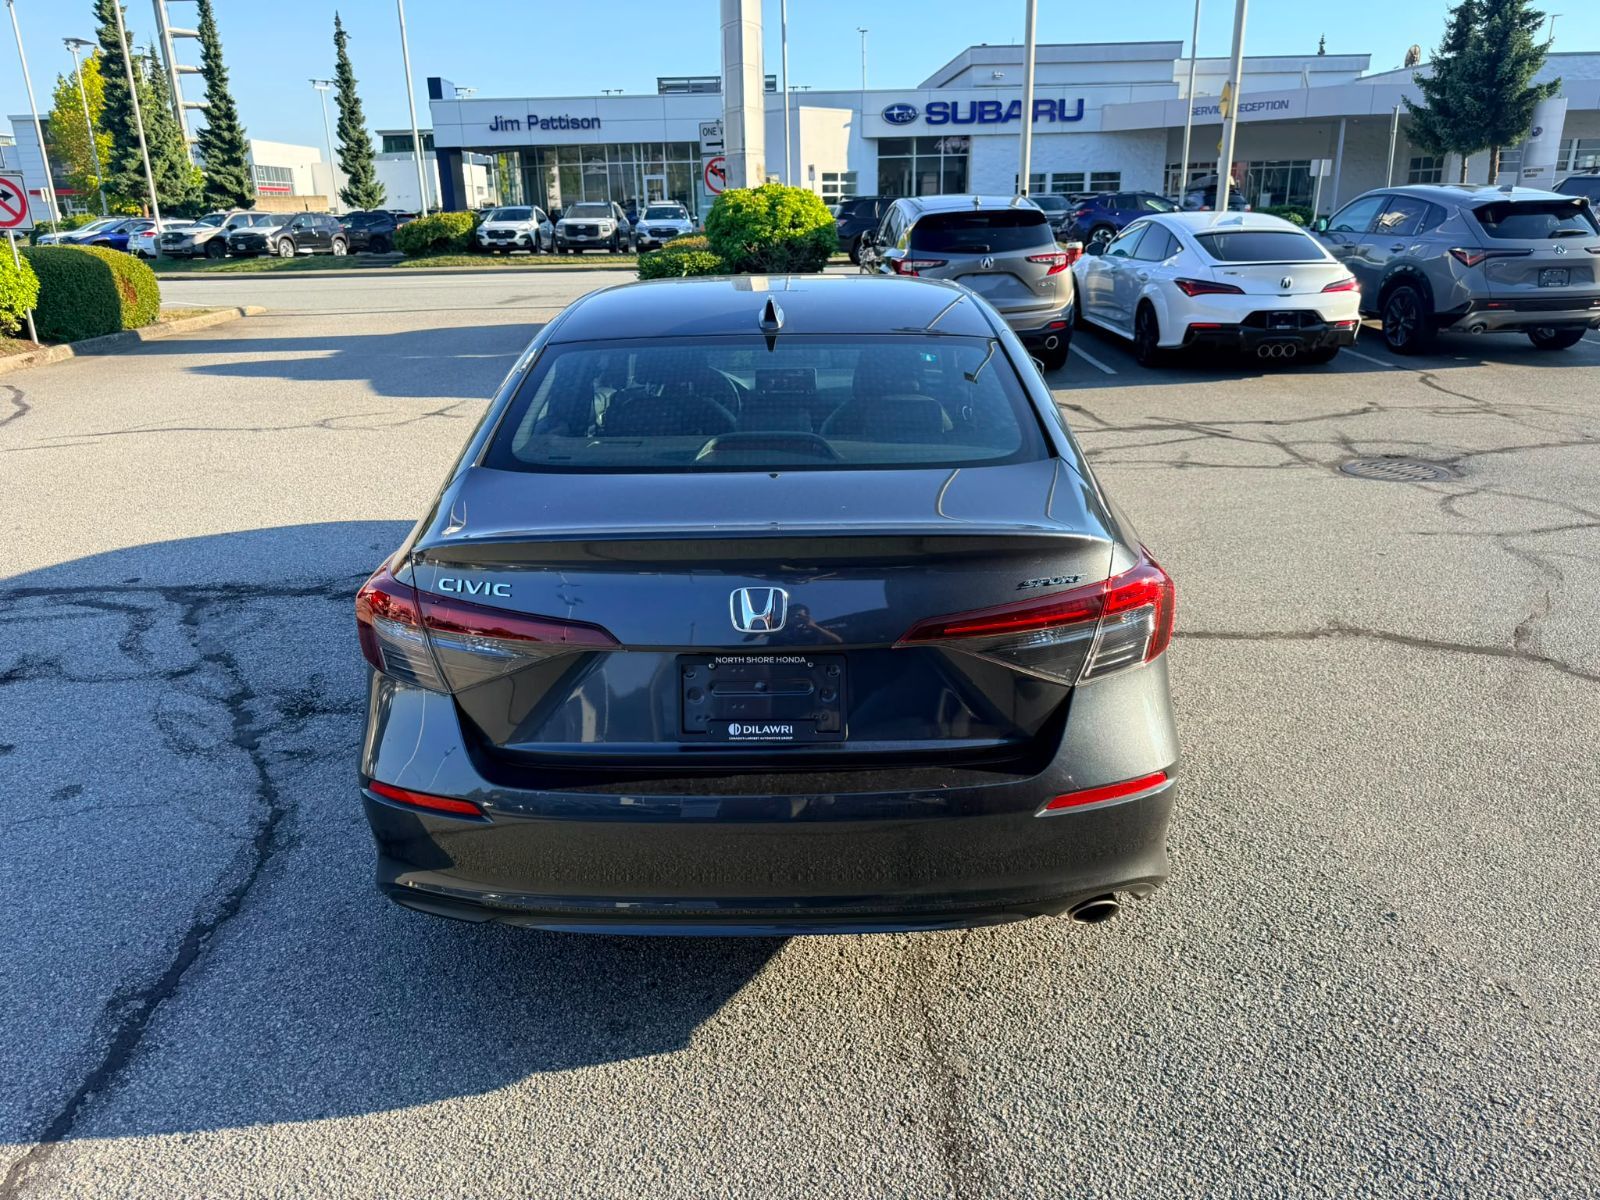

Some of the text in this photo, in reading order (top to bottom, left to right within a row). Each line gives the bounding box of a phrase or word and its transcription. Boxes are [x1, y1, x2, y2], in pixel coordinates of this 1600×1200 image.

[925, 98, 1085, 125] SUBARU
[1238, 99, 1290, 113] ECEPTION
[489, 113, 601, 132] Jim Pattison
[702, 126, 717, 137] ONE
[438, 578, 512, 597] CIVIC
[715, 656, 806, 664] NORTH SHORE HONDA
[743, 725, 793, 734] DILAWRI
